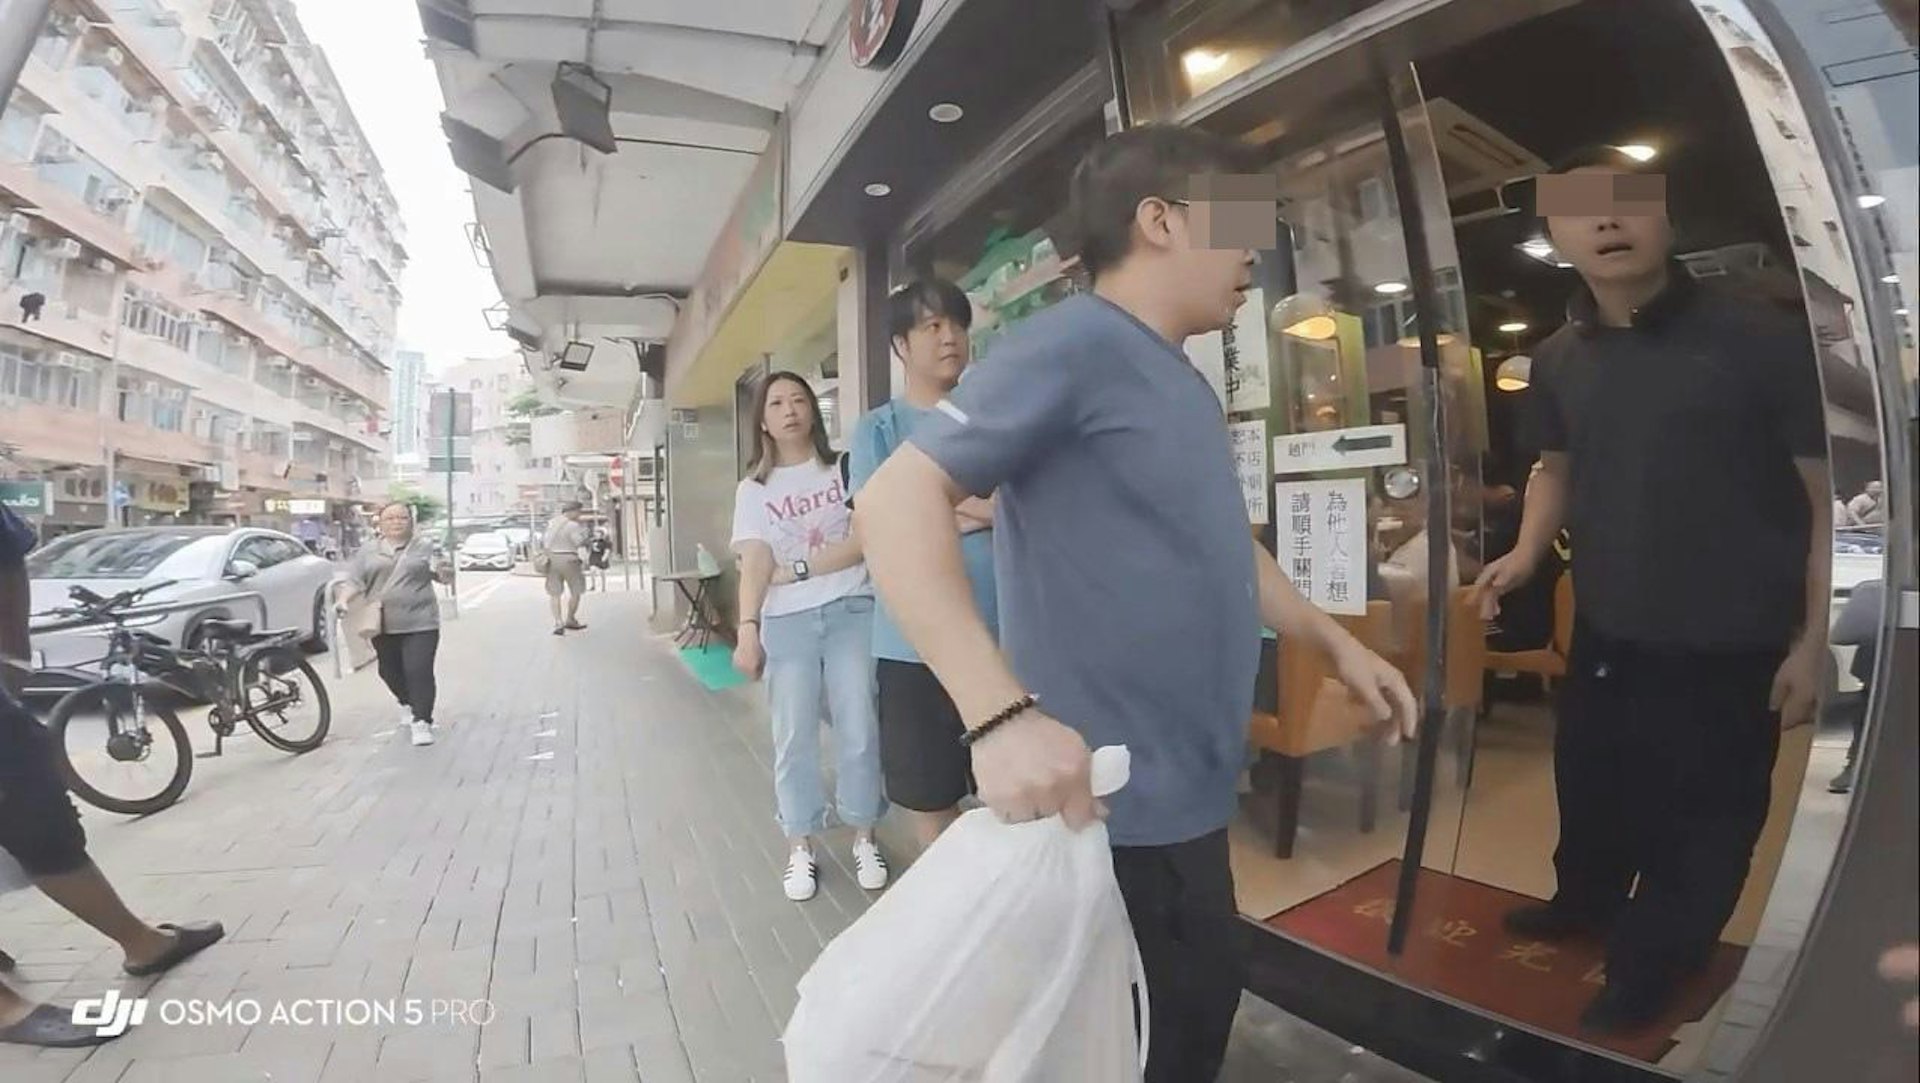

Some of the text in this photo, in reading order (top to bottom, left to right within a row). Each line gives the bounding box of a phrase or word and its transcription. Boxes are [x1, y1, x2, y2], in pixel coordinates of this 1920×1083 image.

[1291, 491, 1313, 602] 請順手關門
